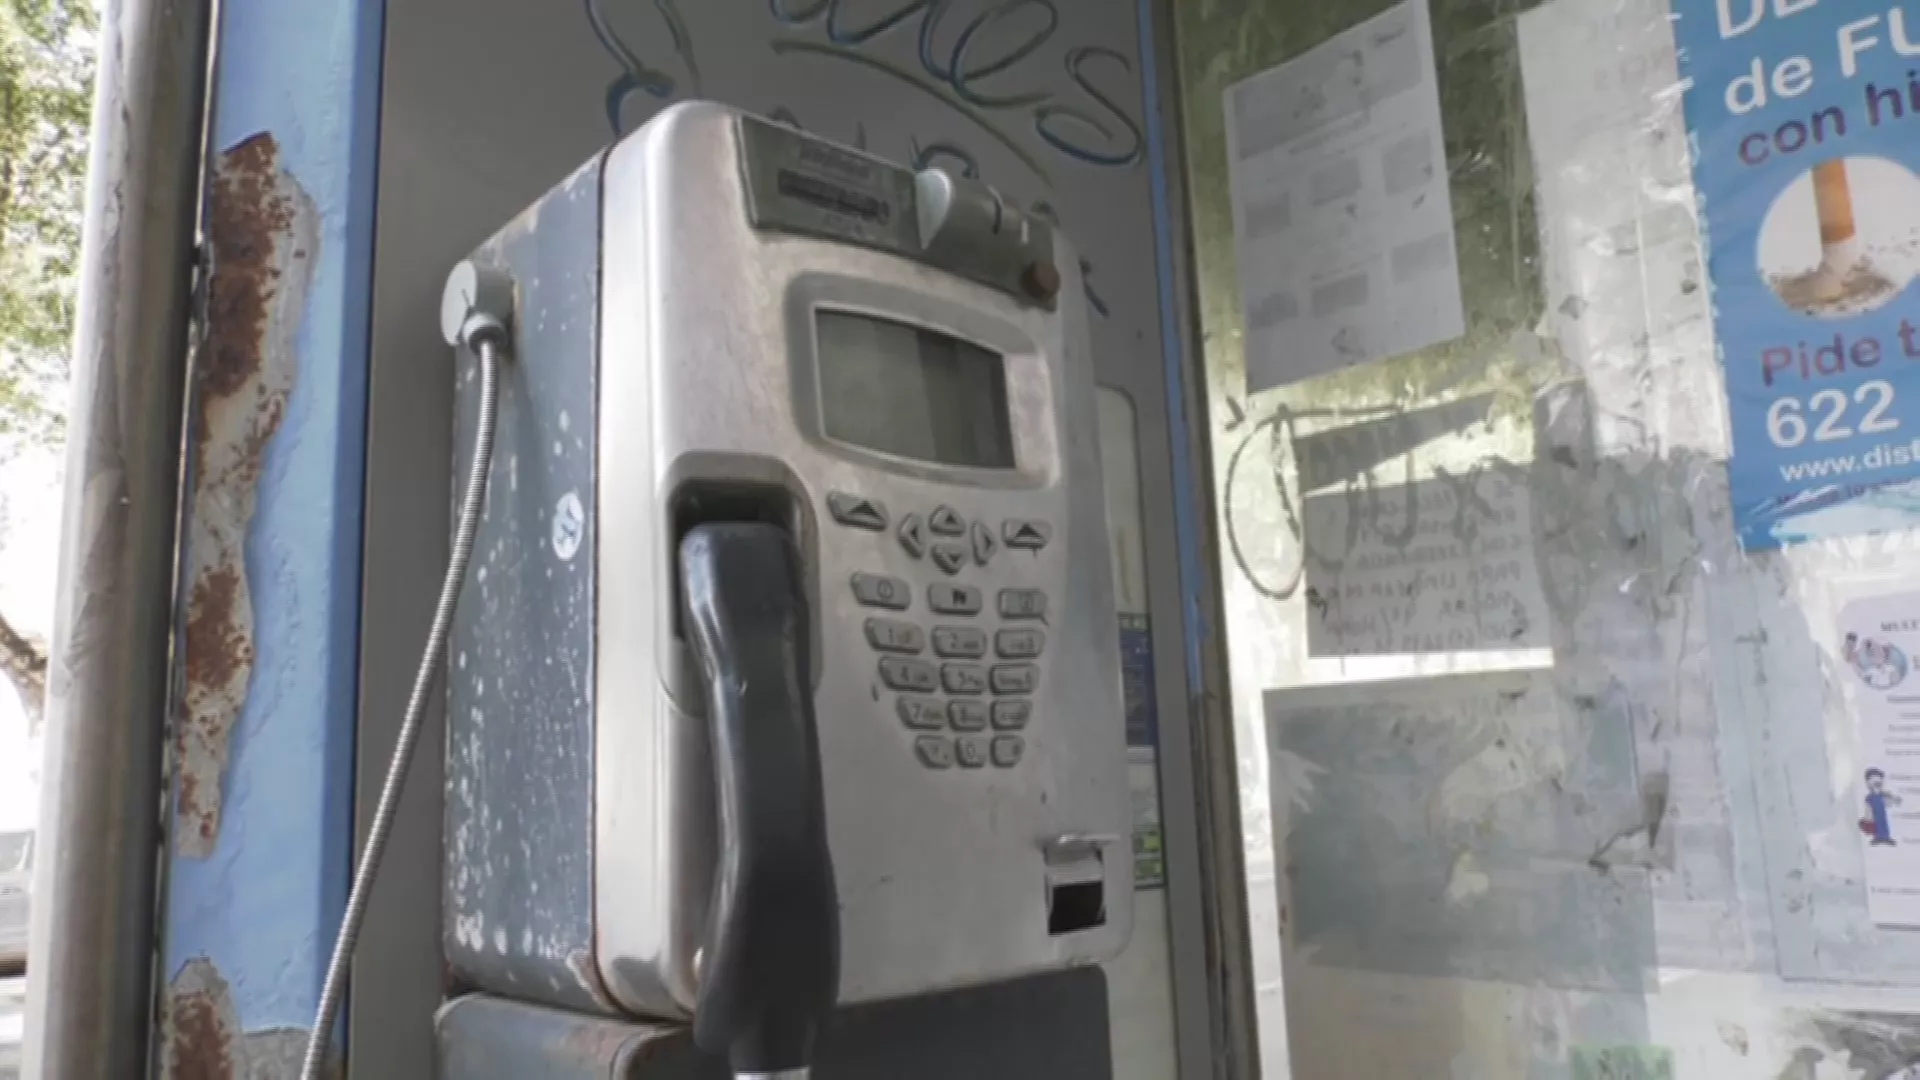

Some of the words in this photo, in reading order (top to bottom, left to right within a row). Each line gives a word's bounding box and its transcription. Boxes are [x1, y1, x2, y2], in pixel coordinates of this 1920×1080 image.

[1724, 55, 1814, 115] de
[1737, 106, 1846, 165] con
[1761, 333, 1882, 388] Pide
[1767, 379, 1900, 448] 622
